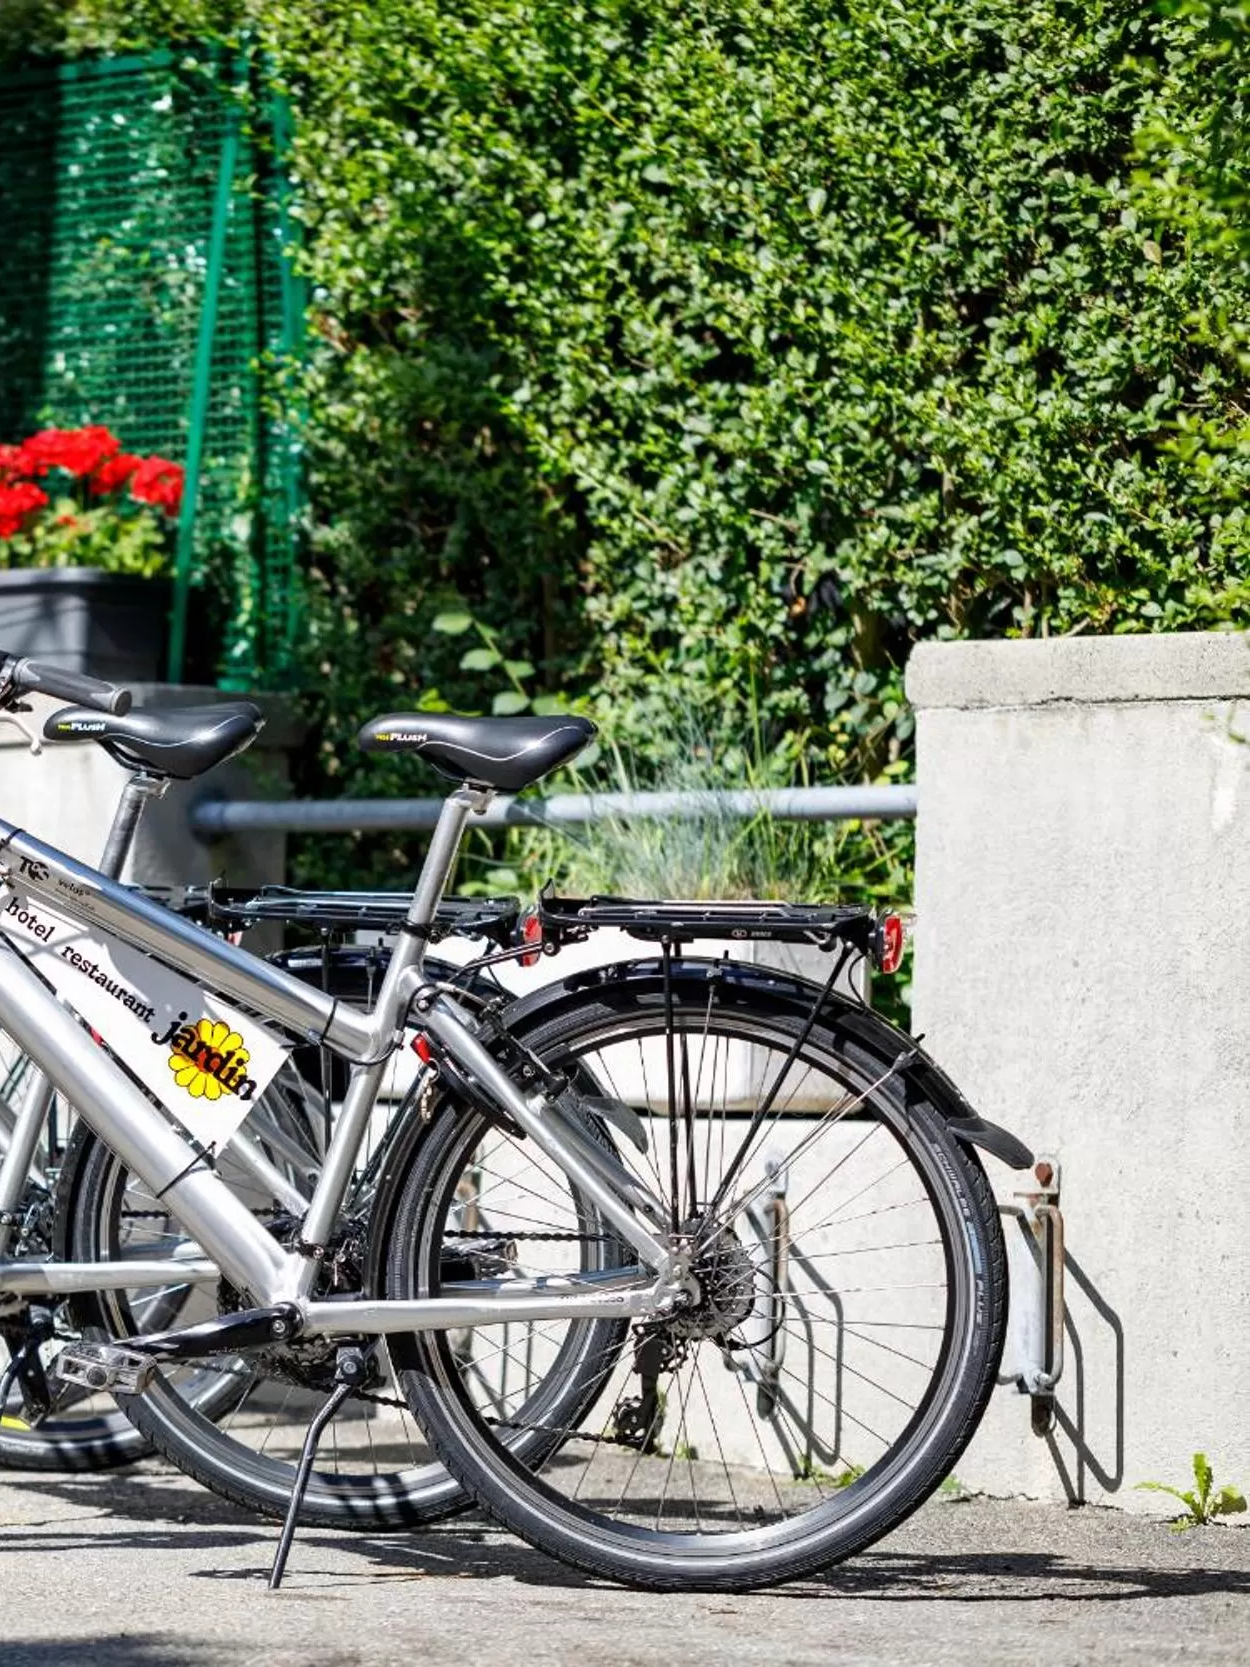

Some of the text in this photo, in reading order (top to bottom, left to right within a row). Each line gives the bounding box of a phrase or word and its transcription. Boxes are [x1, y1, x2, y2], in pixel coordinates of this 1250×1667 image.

[5, 897, 156, 1023] hotel restaurant
[151, 1011, 257, 1100] jardin
